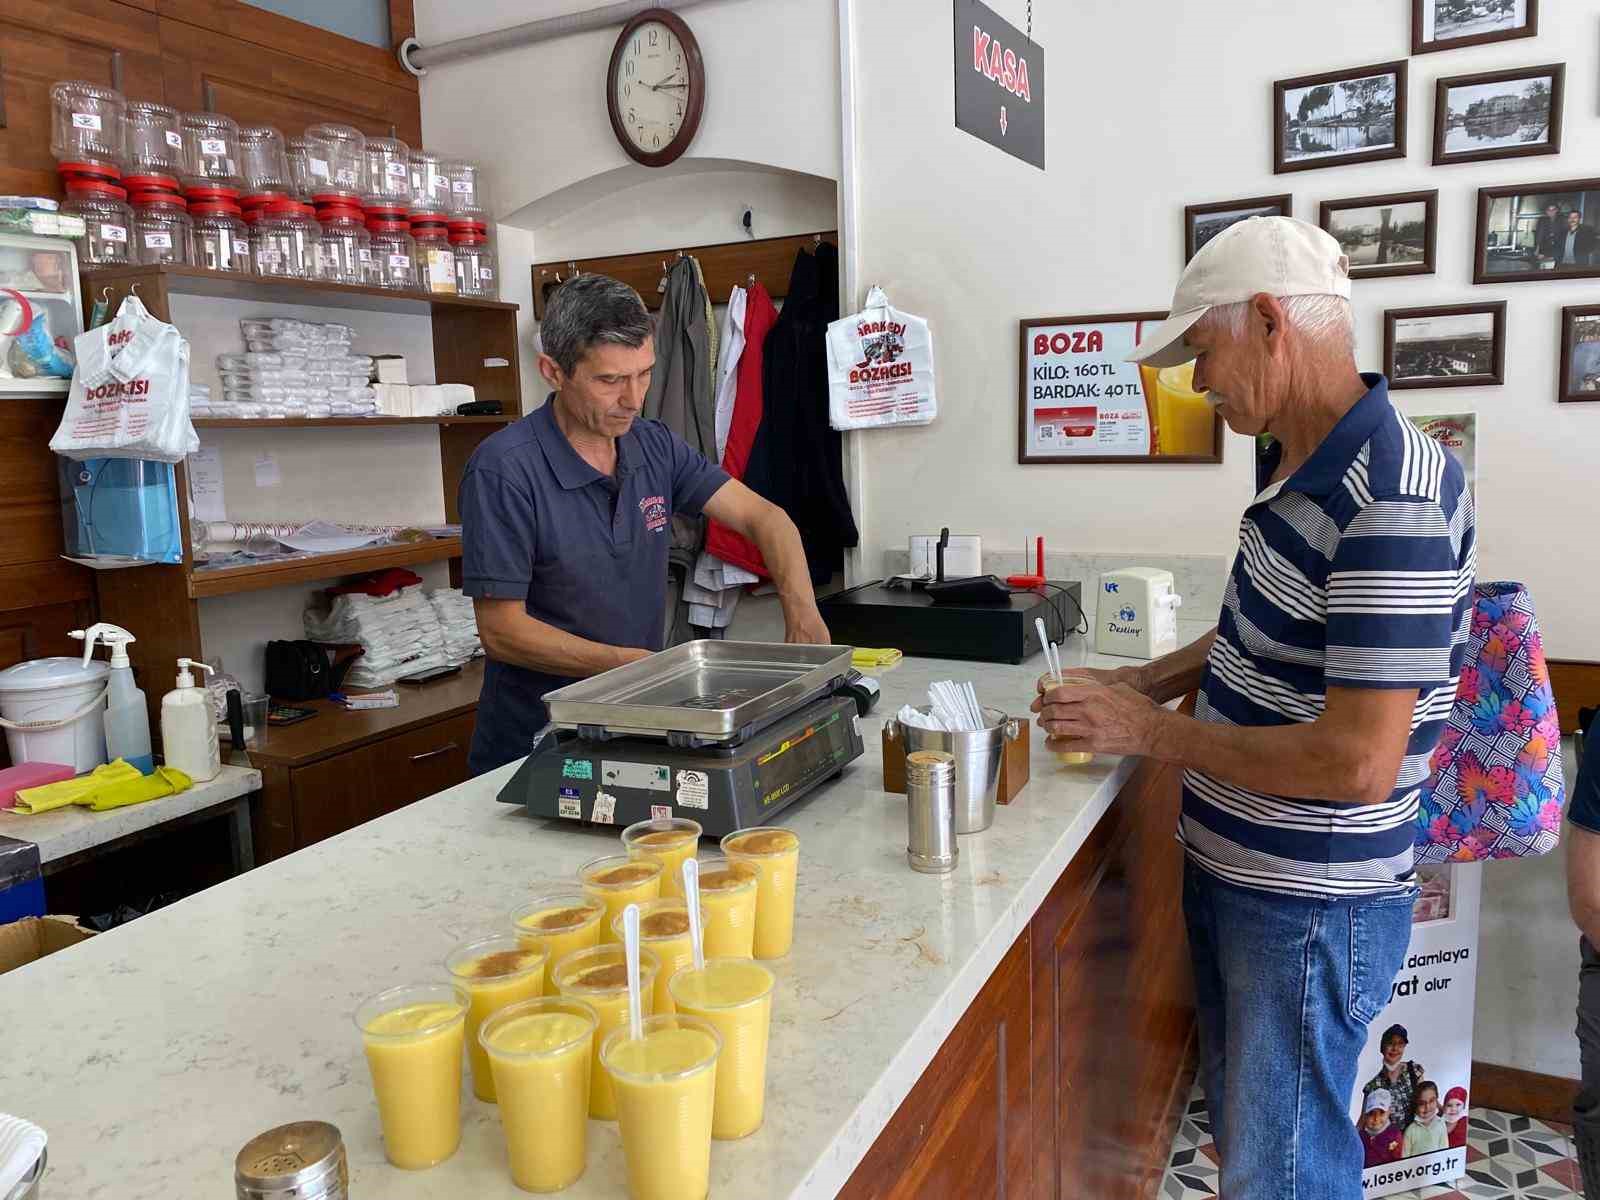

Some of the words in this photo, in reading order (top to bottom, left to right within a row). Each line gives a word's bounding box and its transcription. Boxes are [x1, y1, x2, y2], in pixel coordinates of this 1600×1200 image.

[648, 30, 657, 46] 12
[634, 39, 641, 56] 11
[625, 60, 634, 78] 10
[675, 54, 681, 70] 2
[974, 25, 1031, 103] KASA
[624, 82, 631, 99] 9
[628, 107, 636, 123] 8
[676, 103, 682, 117] 4
[653, 133, 660, 145] 6
[1034, 330, 1103, 356] BOZA
[849, 362, 913, 384] BOZACISI
[1033, 362, 1069, 380] KİLO:
[1033, 384, 1101, 399] BARDAK:
[1107, 622, 1143, 637] Destiny
[1407, 948, 1469, 969] damlaya
[1424, 978, 1451, 992] olur
